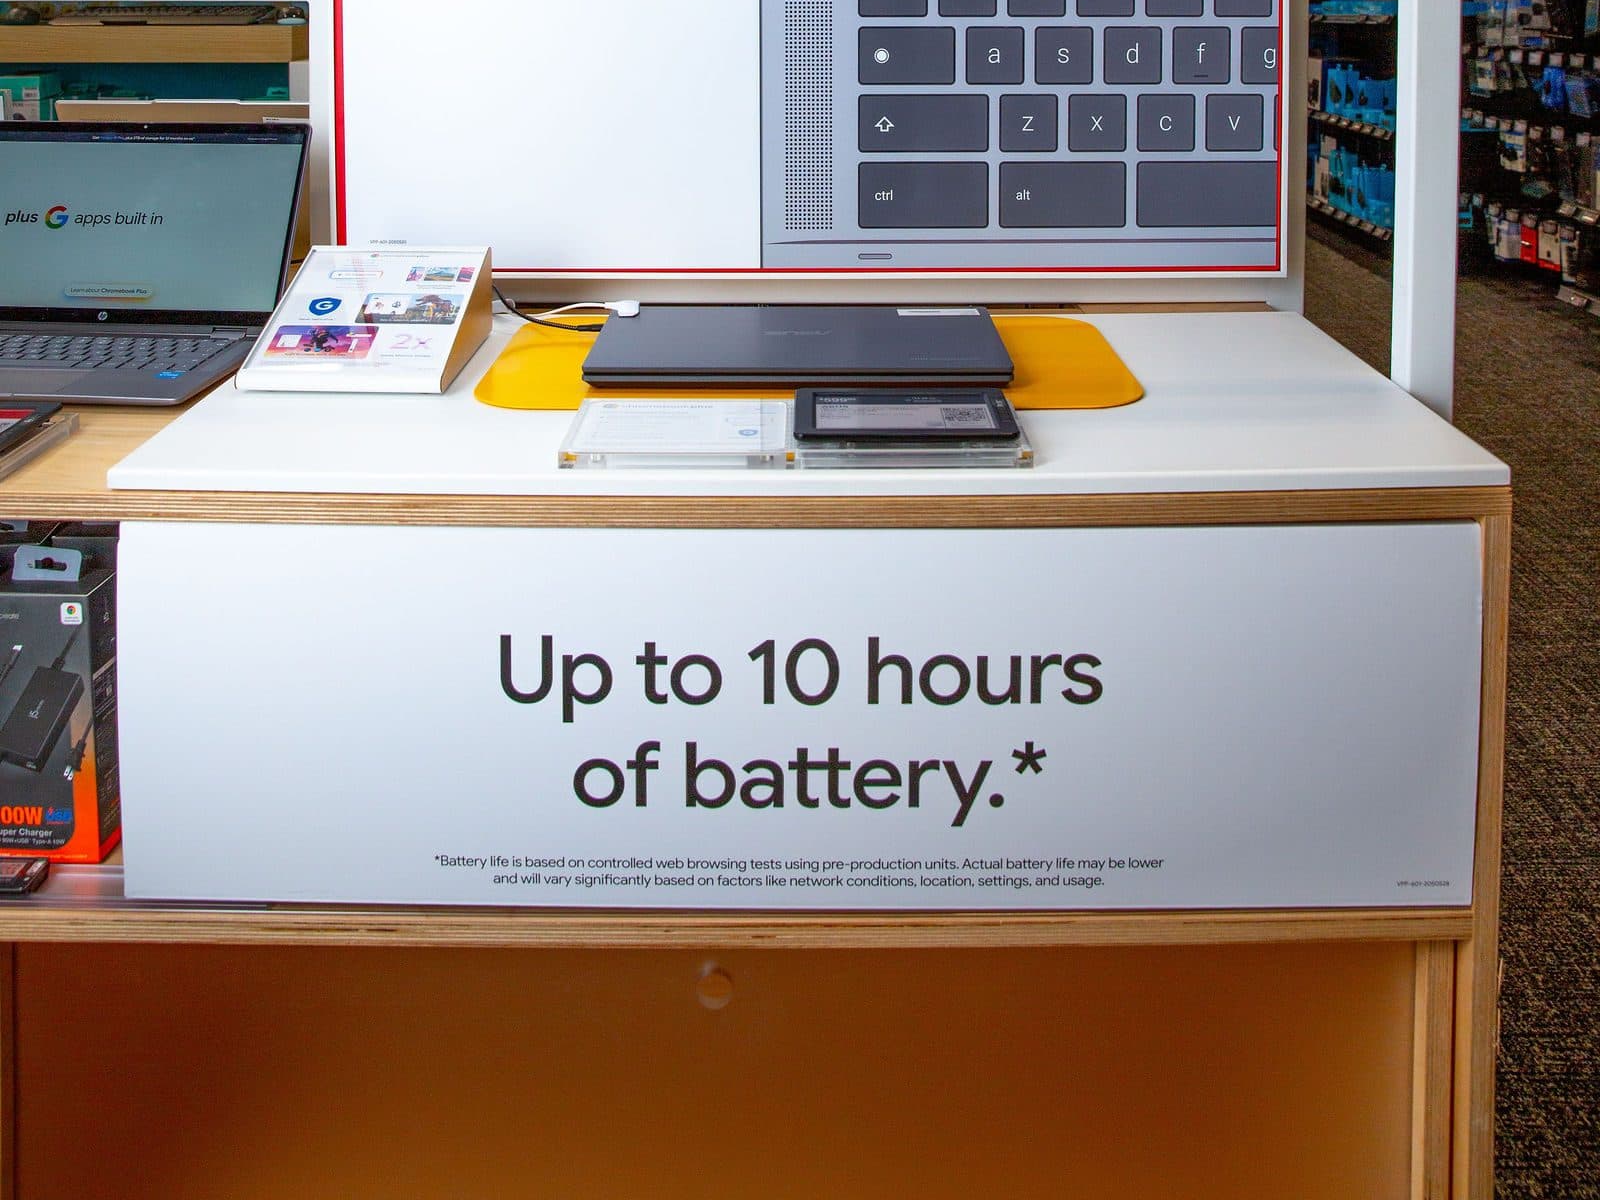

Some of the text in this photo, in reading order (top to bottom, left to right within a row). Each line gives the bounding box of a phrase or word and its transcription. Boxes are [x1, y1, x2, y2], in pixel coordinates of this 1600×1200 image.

[988, 42, 1276, 69] a s d f g
[874, 189, 1031, 201] ctrl alt
[4, 209, 39, 226] plus
[74, 212, 112, 228] apps
[114, 211, 149, 225] built
[150, 211, 164, 225] in
[500, 634, 1104, 724] Up to 10 hours
[573, 740, 661, 809] of
[18, 827, 54, 839] Charger
[490, 855, 509, 868] life
[512, 856, 522, 868] is
[525, 856, 565, 869] based
[567, 859, 585, 869] on
[587, 857, 653, 870] controlled
[655, 858, 685, 870] web
[687, 858, 747, 871] browsing
[750, 859, 782, 870] tests
[784, 858, 820, 872] using
[822, 858, 922, 872] pre-production
[924, 858, 960, 870] units.
[962, 858, 1003, 870] Actual
[1005, 858, 1053, 872] battery
[1055, 857, 1075, 869] life
[1077, 859, 1106, 872] may
[1108, 857, 1126, 869] be
[1128, 857, 1165, 870] lower
[493, 873, 1105, 890] and will vary significantly based on factors like network conditions, location, settings, and usage.
